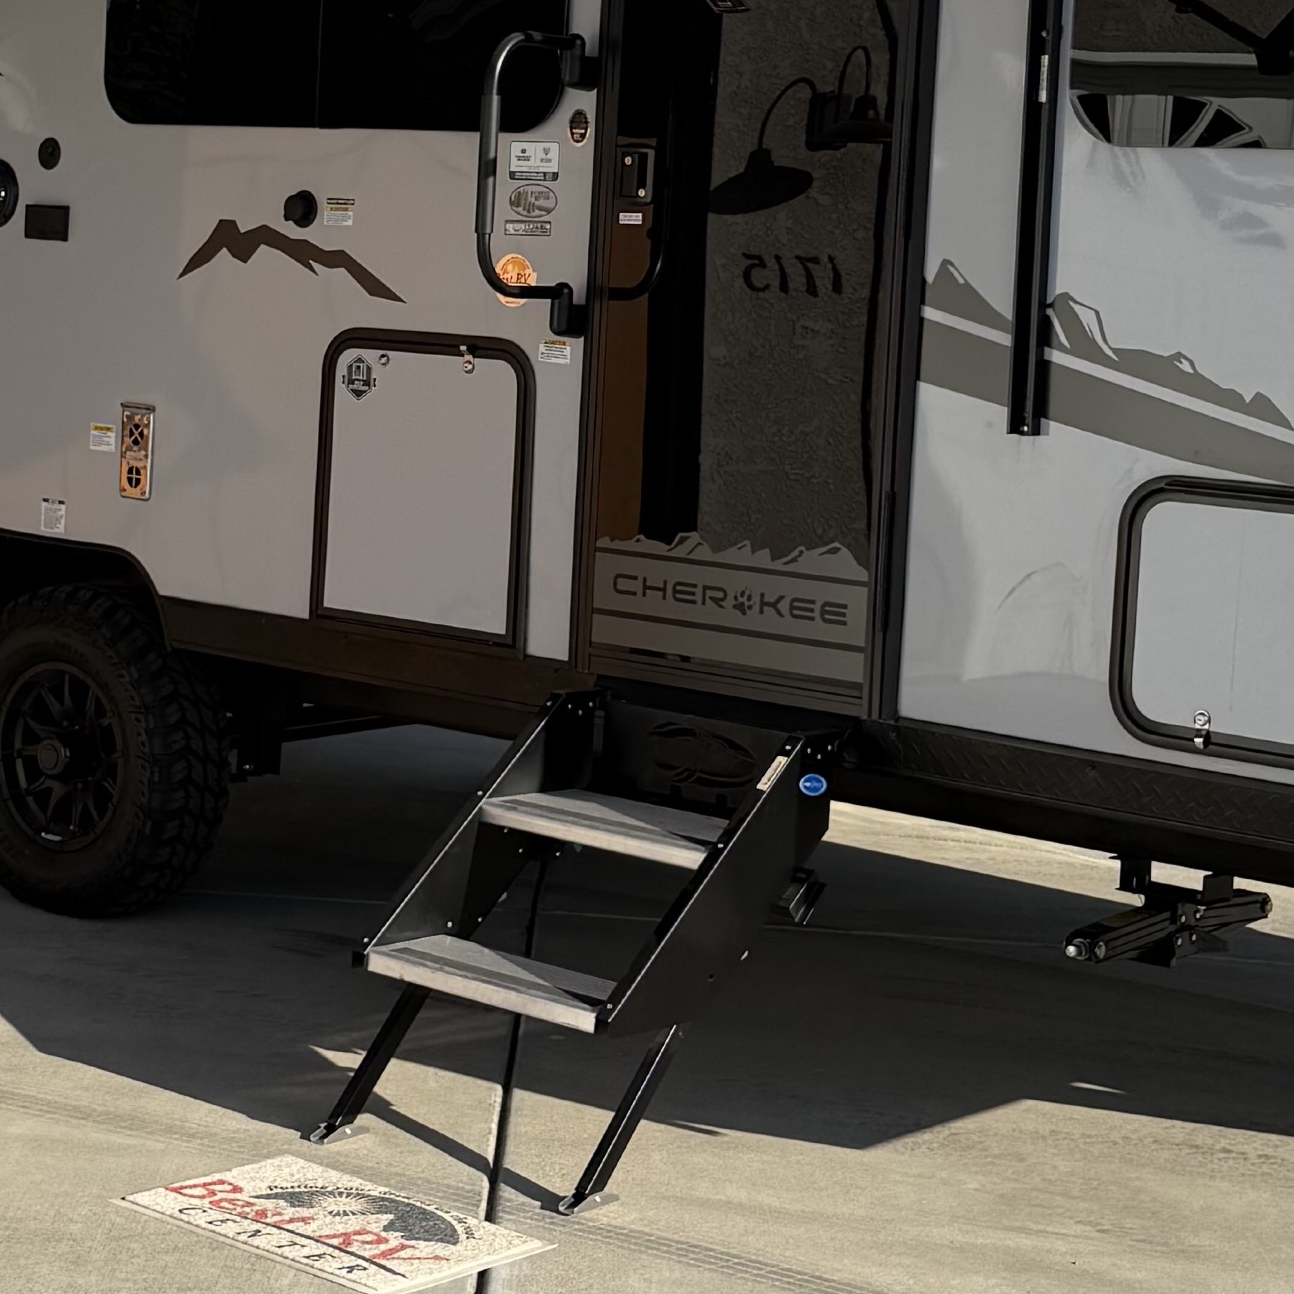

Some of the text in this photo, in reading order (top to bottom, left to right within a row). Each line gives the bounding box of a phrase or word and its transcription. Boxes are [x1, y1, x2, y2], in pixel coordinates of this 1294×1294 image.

[612, 572, 849, 627] CHEROKEE
[165, 1179, 451, 1262] Best RV
[178, 1206, 369, 1274] CENTER
